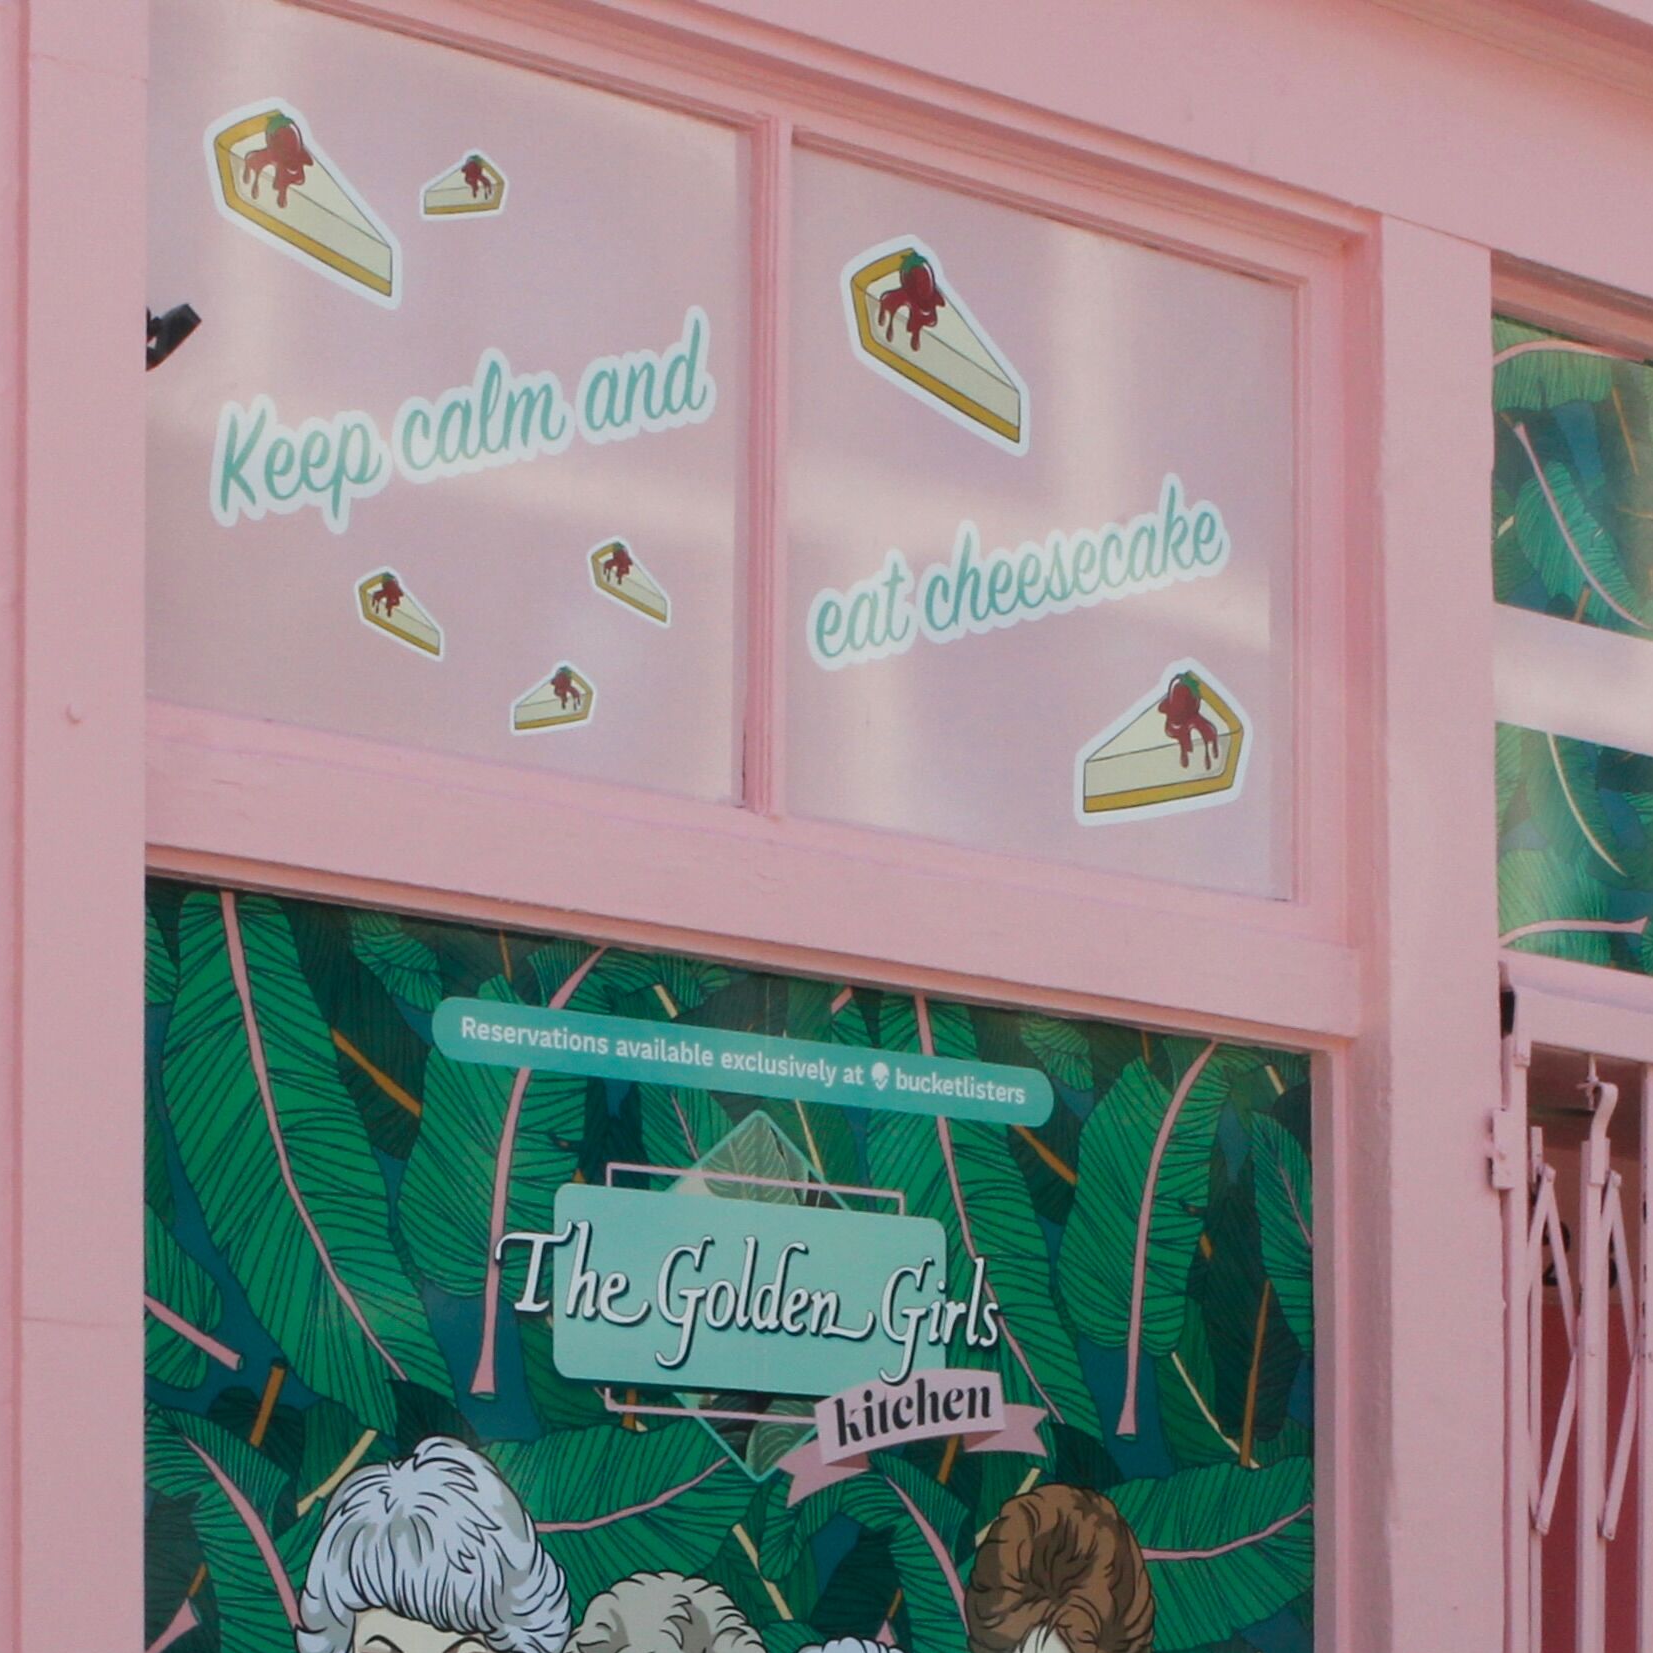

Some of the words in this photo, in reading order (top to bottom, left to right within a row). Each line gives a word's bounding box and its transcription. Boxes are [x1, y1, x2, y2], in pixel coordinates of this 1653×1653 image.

[220, 407, 382, 521] Keep
[401, 360, 566, 471] calm
[584, 319, 707, 432] and
[814, 561, 911, 658] eat
[925, 484, 1223, 632] cheesecake
[461, 1016, 609, 1055] Reservations
[615, 1037, 714, 1067] available
[720, 1051, 837, 1088] exclusively
[843, 1065, 864, 1086] at
[896, 1068, 1026, 1105] bucketlisters
[495, 1220, 649, 1324] The
[654, 1235, 874, 1367] Golden
[877, 1256, 1001, 1384] Girls
[834, 1378, 992, 1449] kitchen
